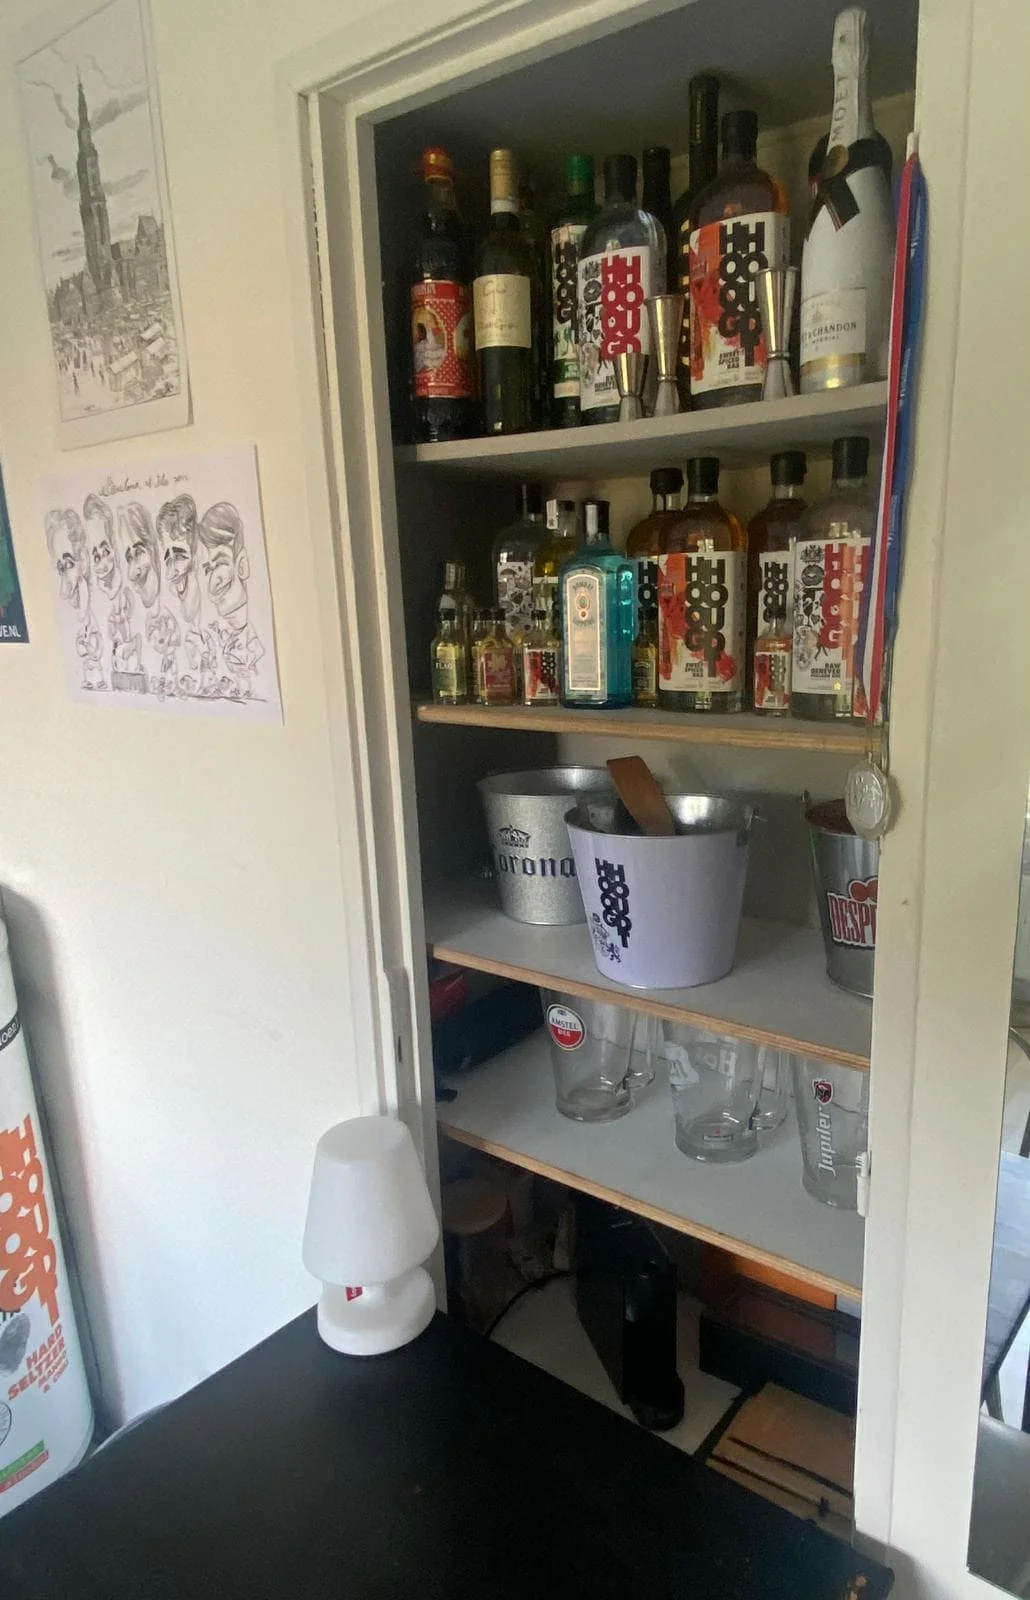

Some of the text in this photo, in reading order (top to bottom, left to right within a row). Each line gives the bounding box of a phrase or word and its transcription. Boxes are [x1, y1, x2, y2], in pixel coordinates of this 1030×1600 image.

[815, 1104, 836, 1176] Jupiler
[8, 1336, 65, 1401] SELTZER
[26, 1323, 63, 1370] HARD
